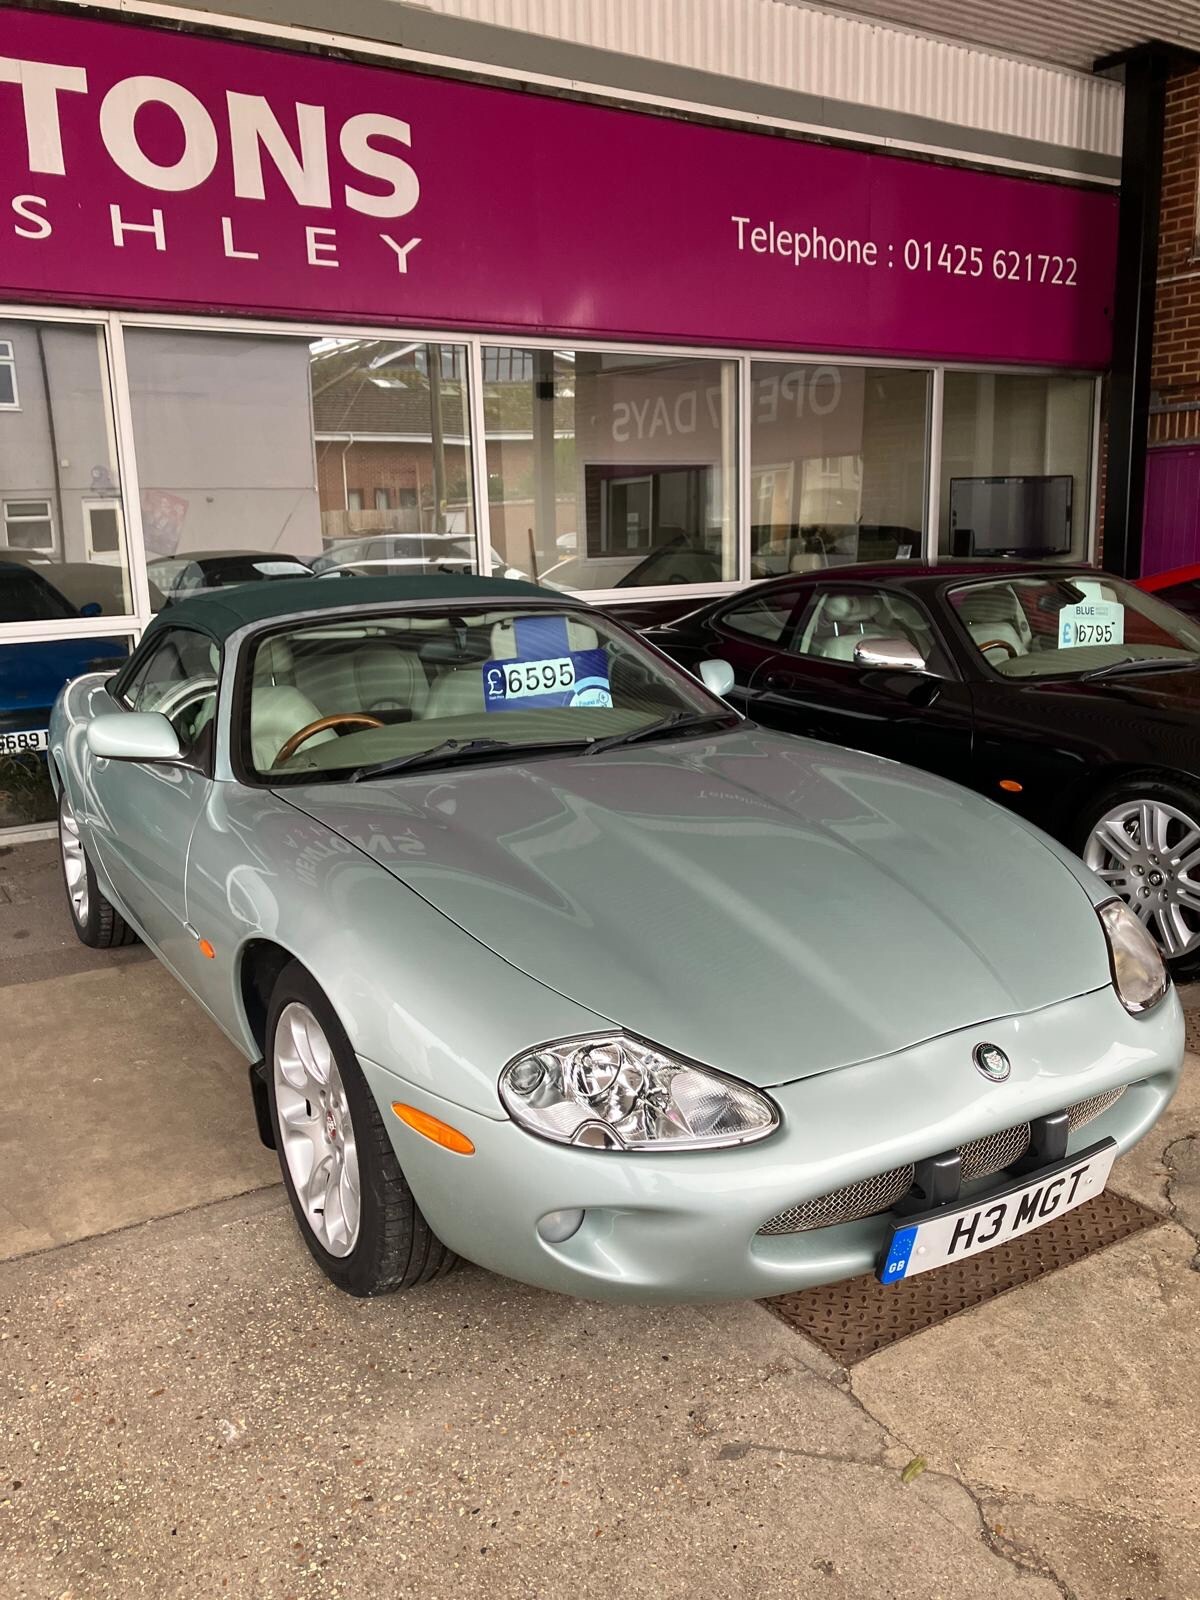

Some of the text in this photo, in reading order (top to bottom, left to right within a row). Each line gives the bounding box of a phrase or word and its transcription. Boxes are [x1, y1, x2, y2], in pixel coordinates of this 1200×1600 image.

[0, 56, 420, 218] TONS
[11, 194, 422, 274] SHLEY
[731, 216, 878, 266] Telephone
[904, 238, 984, 277] 01425
[992, 249, 1078, 286] 621722
[1075, 605, 1095, 616] BLUE
[947, 1164, 1090, 1256] H3 MGT
[888, 1260, 905, 1274] GB
